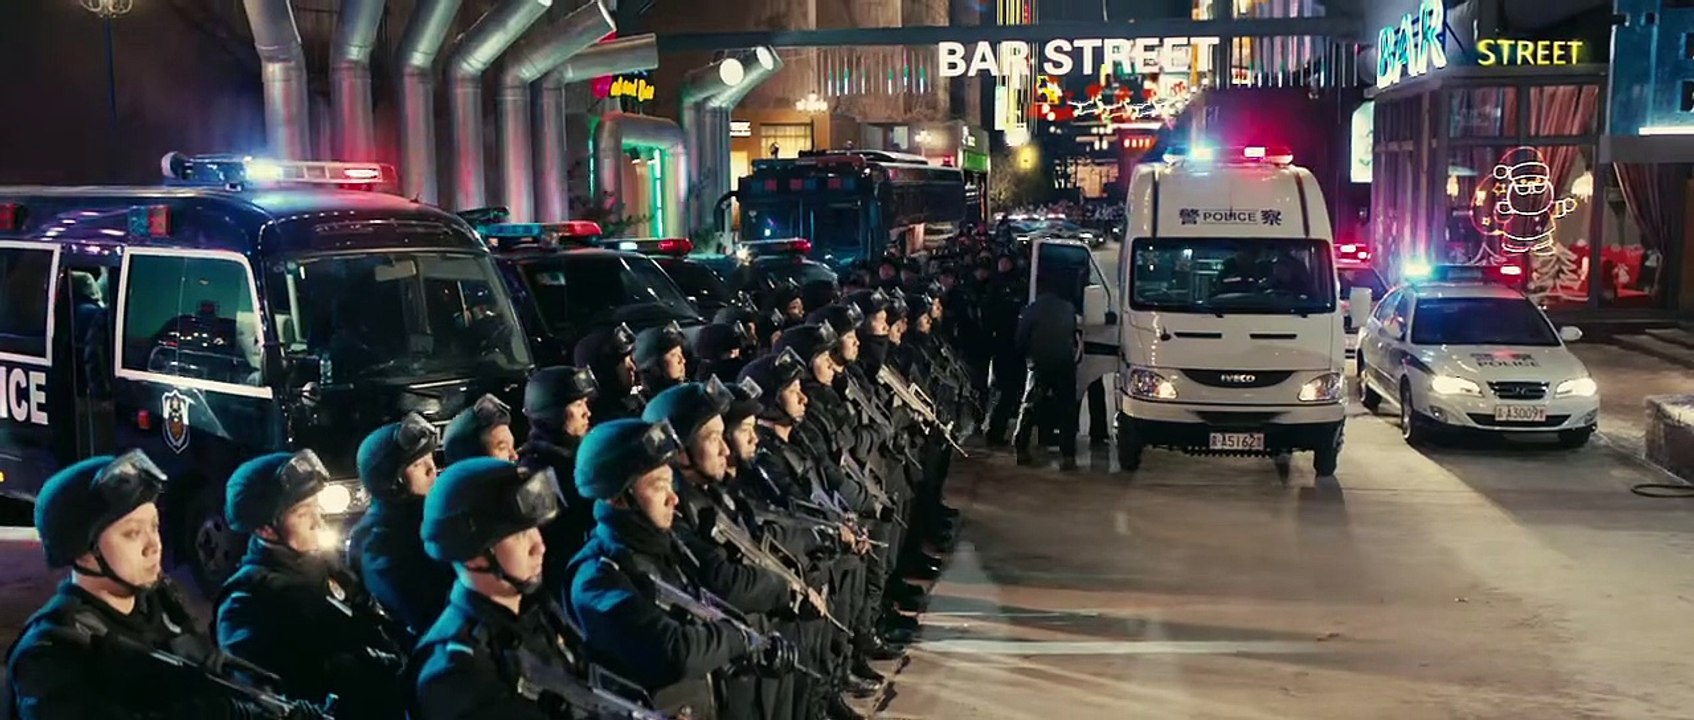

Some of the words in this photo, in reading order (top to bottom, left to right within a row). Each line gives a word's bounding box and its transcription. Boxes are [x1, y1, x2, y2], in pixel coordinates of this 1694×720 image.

[1377, 0, 1447, 89] BAR
[1476, 38, 1584, 66] STREET
[938, 41, 1030, 77] BAR
[1043, 37, 1219, 75] STREET
[1203, 211, 1257, 222] POLICE
[1261, 209, 1282, 226] 察
[1477, 359, 1541, 368] POLICE
[1221, 374, 1256, 382] IVECO
